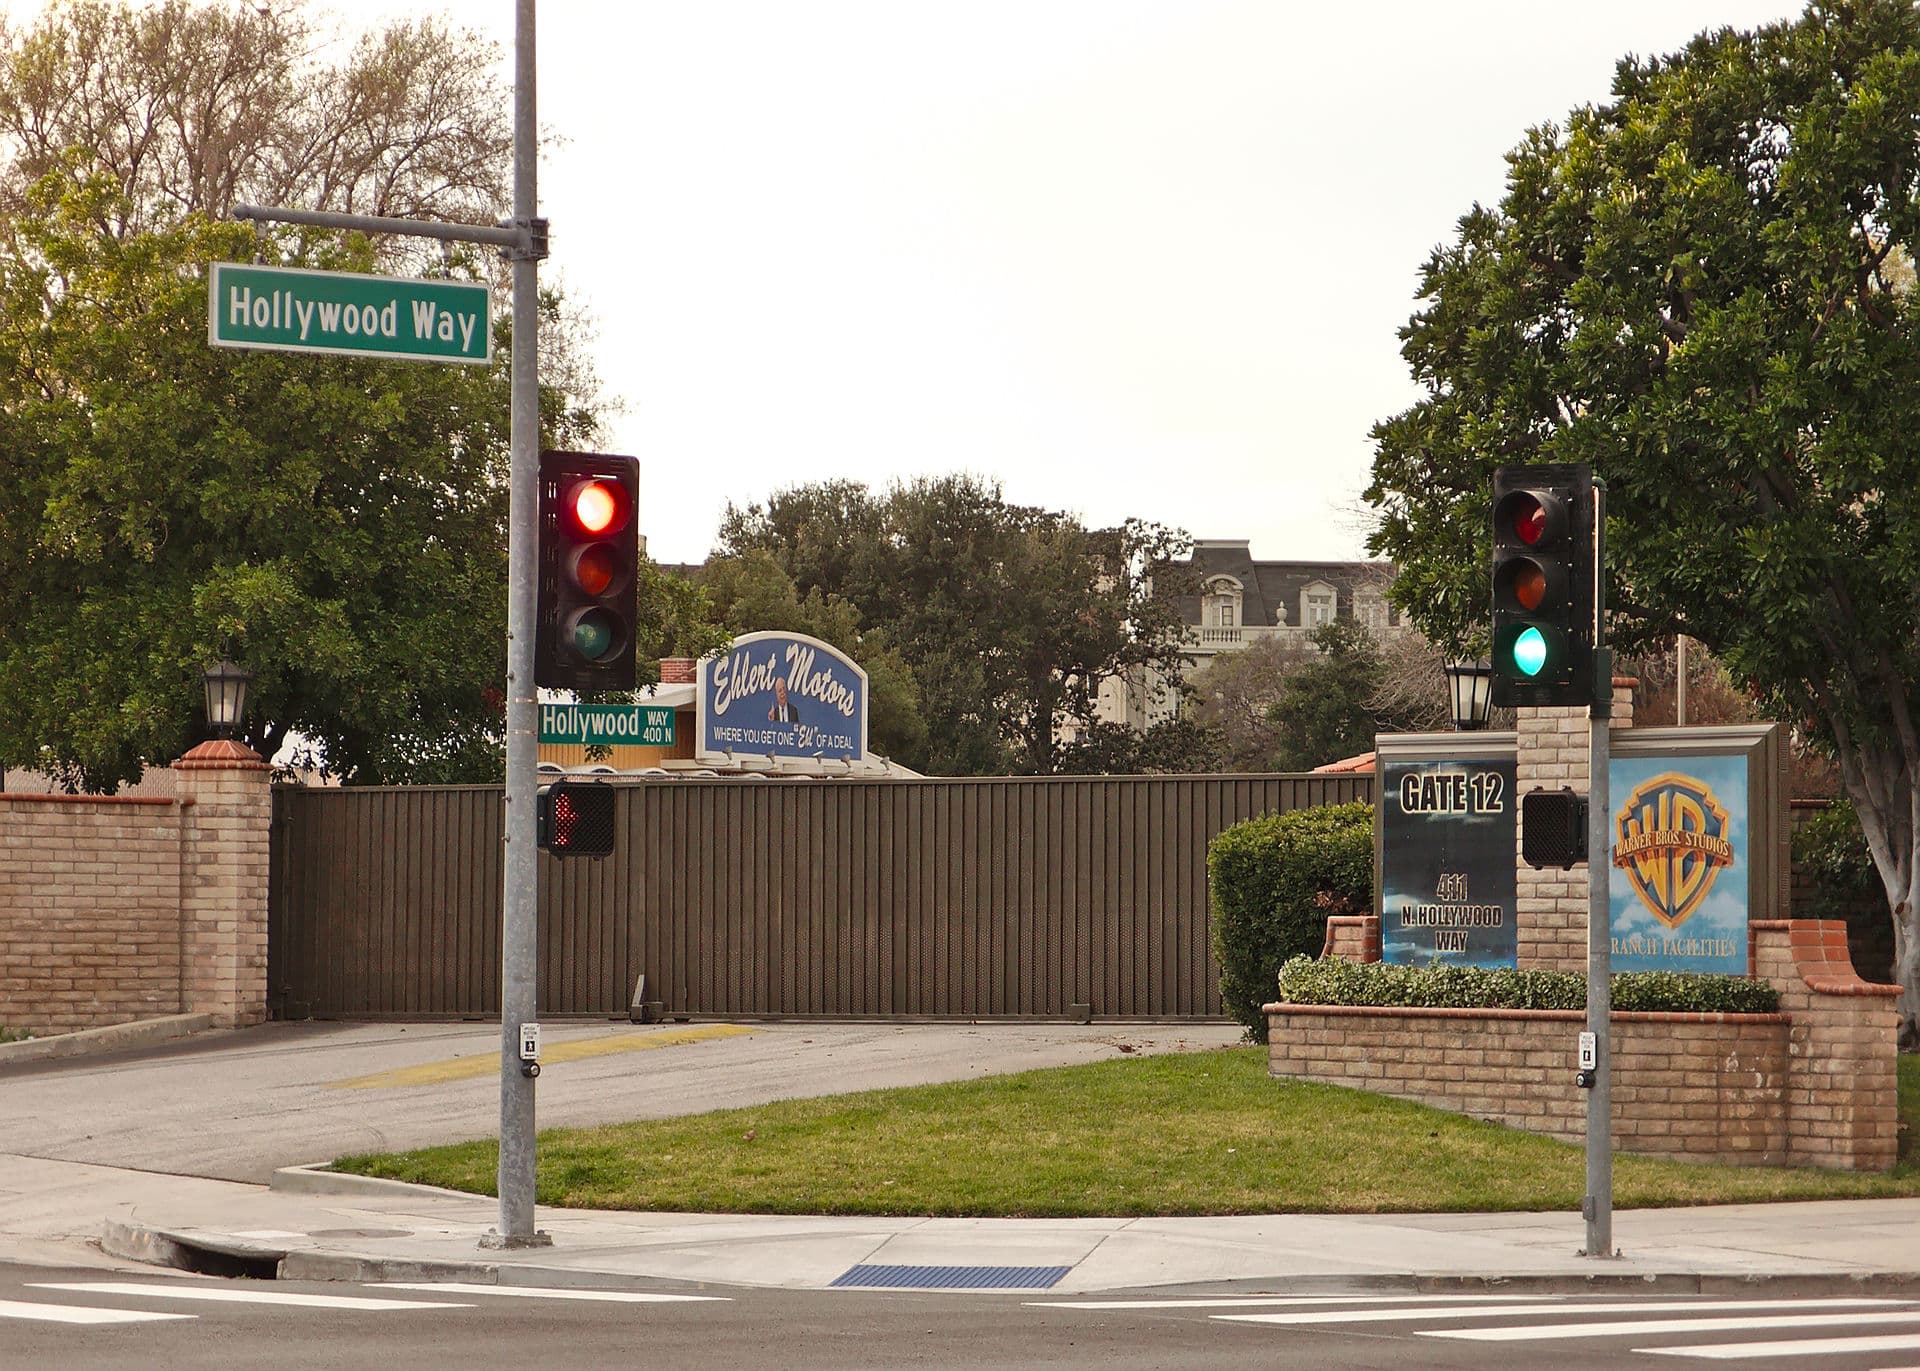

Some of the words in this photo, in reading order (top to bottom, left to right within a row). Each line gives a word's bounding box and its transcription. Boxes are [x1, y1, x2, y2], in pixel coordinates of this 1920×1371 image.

[230, 285, 397, 341] Hollywood
[412, 299, 476, 352] Way
[713, 651, 777, 716] Ehlert
[786, 643, 855, 717] Motors
[543, 705, 639, 742] Hollywood
[647, 711, 669, 726] WAY
[643, 727, 662, 742] 400
[665, 728, 672, 742] N
[713, 726, 742, 742] WHERE
[743, 728, 760, 743] YOU
[760, 730, 777, 745] GET
[777, 731, 794, 746] ONE
[816, 734, 827, 748] OF
[827, 735, 834, 748] A
[834, 735, 853, 749] DEAL
[1401, 772, 1467, 813] GATE
[1471, 772, 1504, 813] 12
[1616, 833, 1652, 857] WARNER
[1656, 830, 1681, 846] BROS.
[1685, 832, 1729, 857] STUDIOS
[1437, 873, 1468, 901] 411
[1401, 904, 1416, 927] N.
[1417, 904, 1503, 927] HOLLYWOOD
[1435, 930, 1468, 952] WAY
[1611, 937, 1657, 956] RANCH
[1663, 937, 1737, 957] FACILITIES
